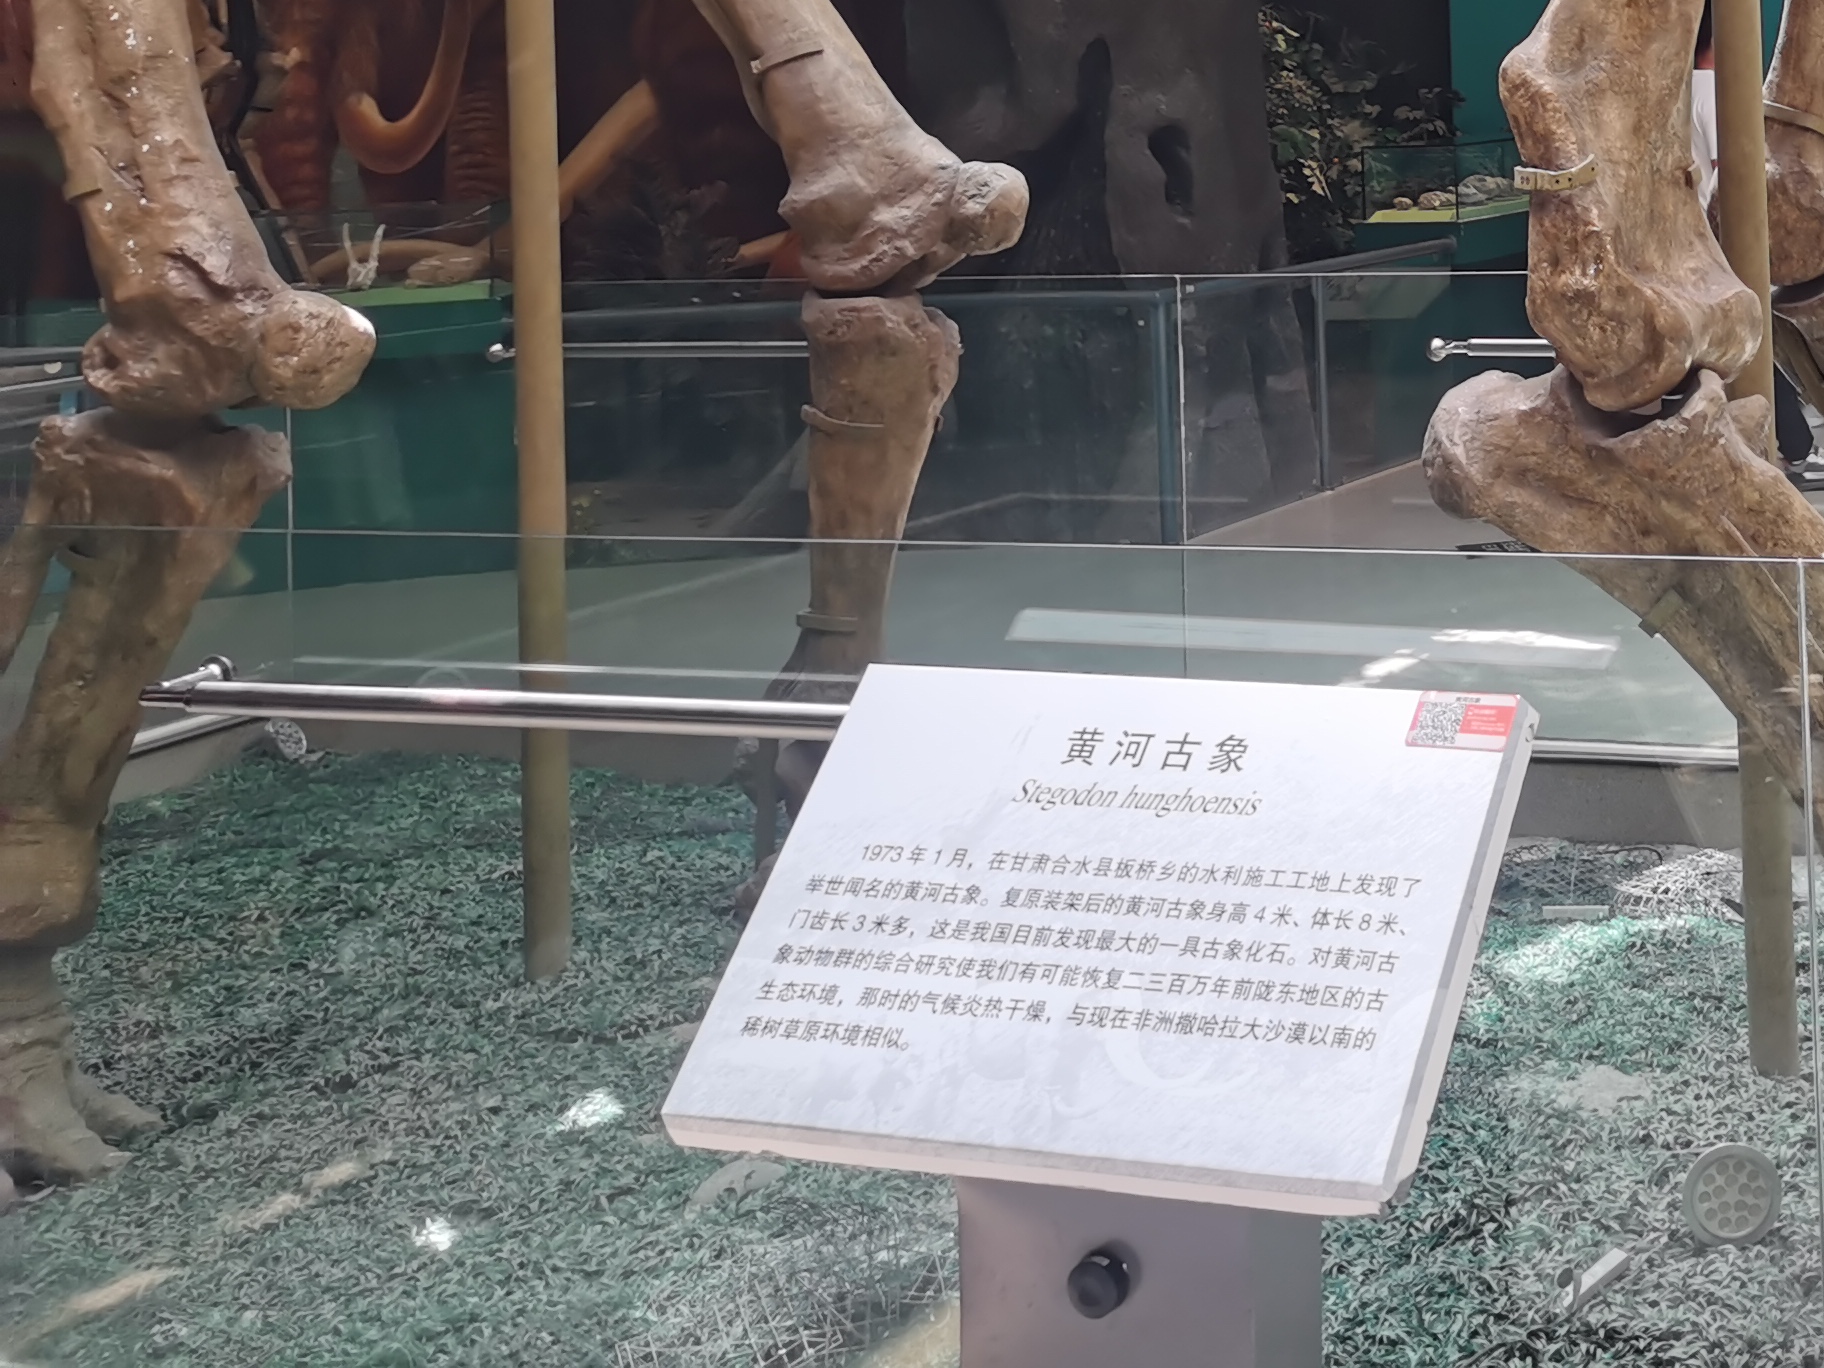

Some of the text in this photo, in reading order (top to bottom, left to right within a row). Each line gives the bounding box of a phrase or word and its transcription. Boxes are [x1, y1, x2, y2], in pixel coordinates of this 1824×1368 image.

[1060, 727, 1249, 773] 黄河古象
[1011, 779, 1263, 818] Stegodon hunghoensis
[740, 1015, 910, 1052] 稀树草原环境相似。
